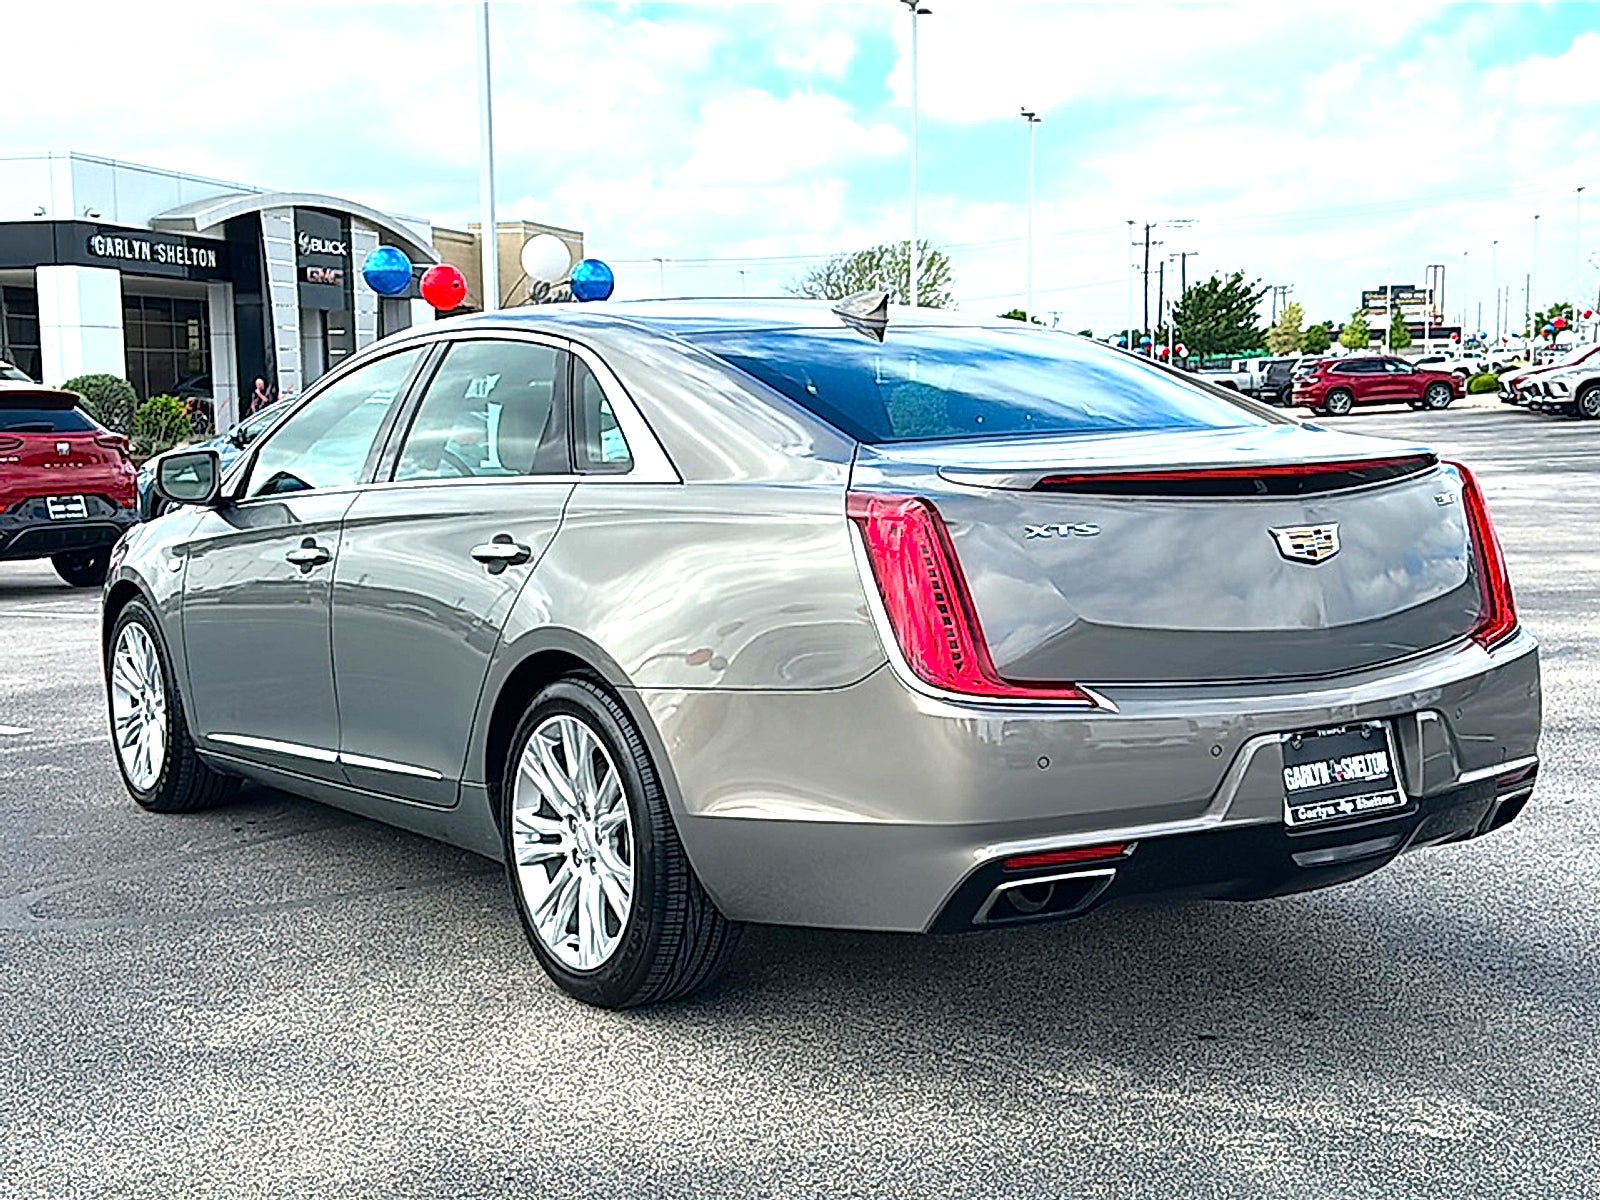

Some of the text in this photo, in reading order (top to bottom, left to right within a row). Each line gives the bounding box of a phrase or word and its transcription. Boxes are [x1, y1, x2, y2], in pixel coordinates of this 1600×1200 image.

[94, 235, 216, 267] GARLYN SHELTON
[310, 238, 347, 256] BUICK
[1024, 523, 1100, 539] XTS
[1284, 751, 1389, 790] GARLYN SHELTON
